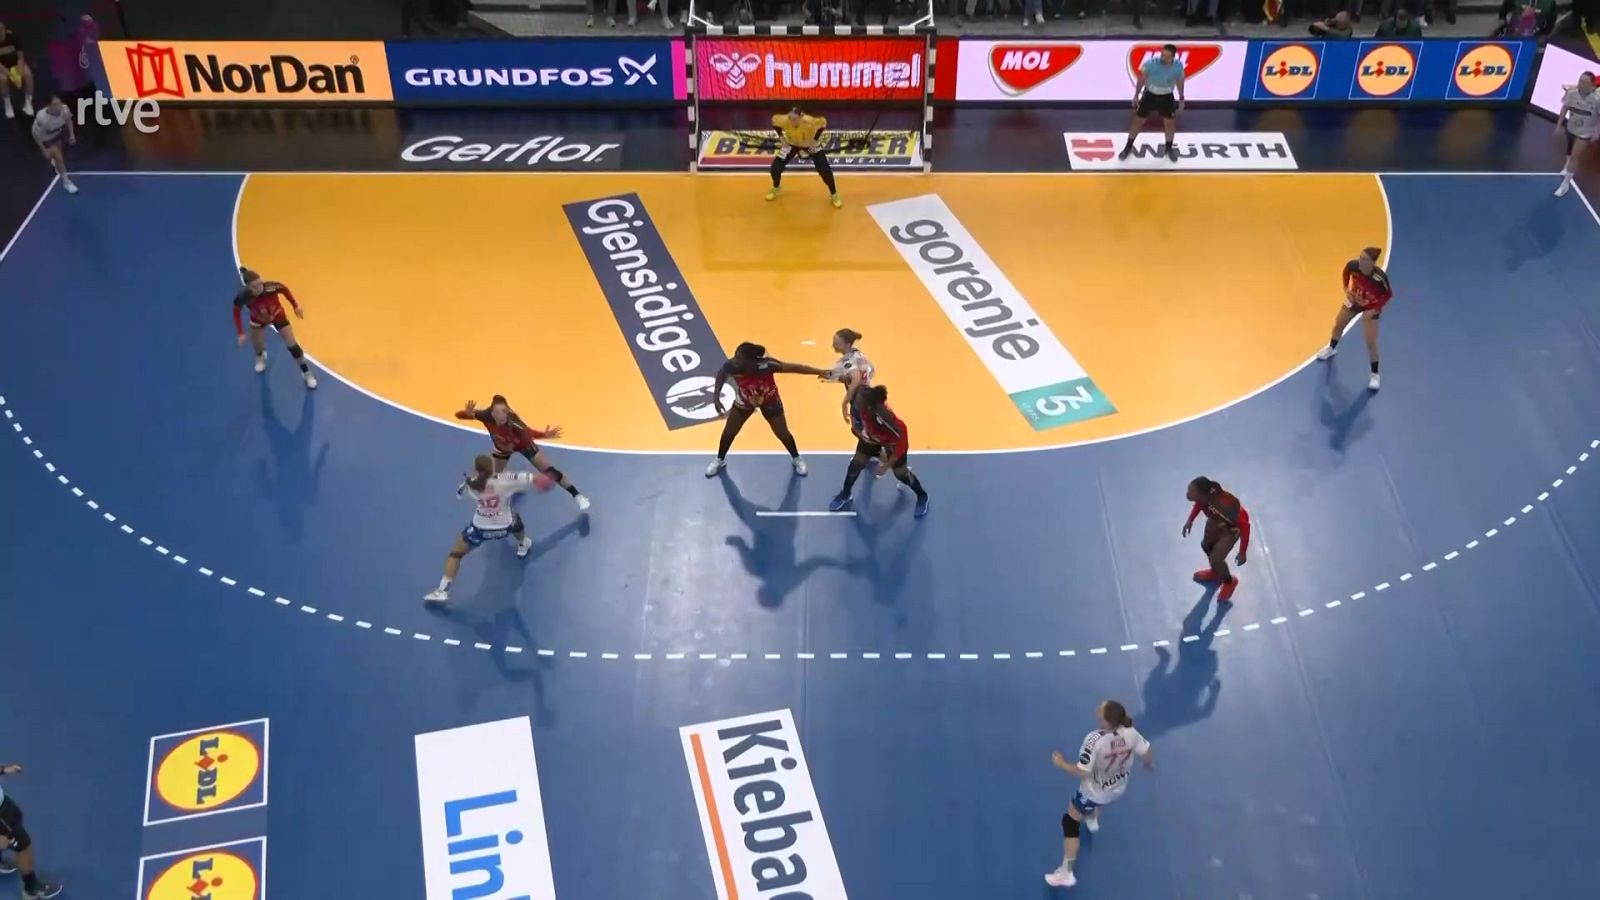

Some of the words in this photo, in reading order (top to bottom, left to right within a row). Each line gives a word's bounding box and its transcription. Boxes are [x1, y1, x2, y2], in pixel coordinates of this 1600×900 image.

[405, 68, 614, 86] GRUNDFOS
[764, 53, 921, 88] hummel
[1000, 51, 1051, 70] MOL
[1138, 51, 1190, 70] ML
[582, 199, 701, 373] Gjensidige
[889, 219, 1040, 360] gorenje
[444, 789, 531, 900] Lin
[717, 719, 814, 900] Kieba
